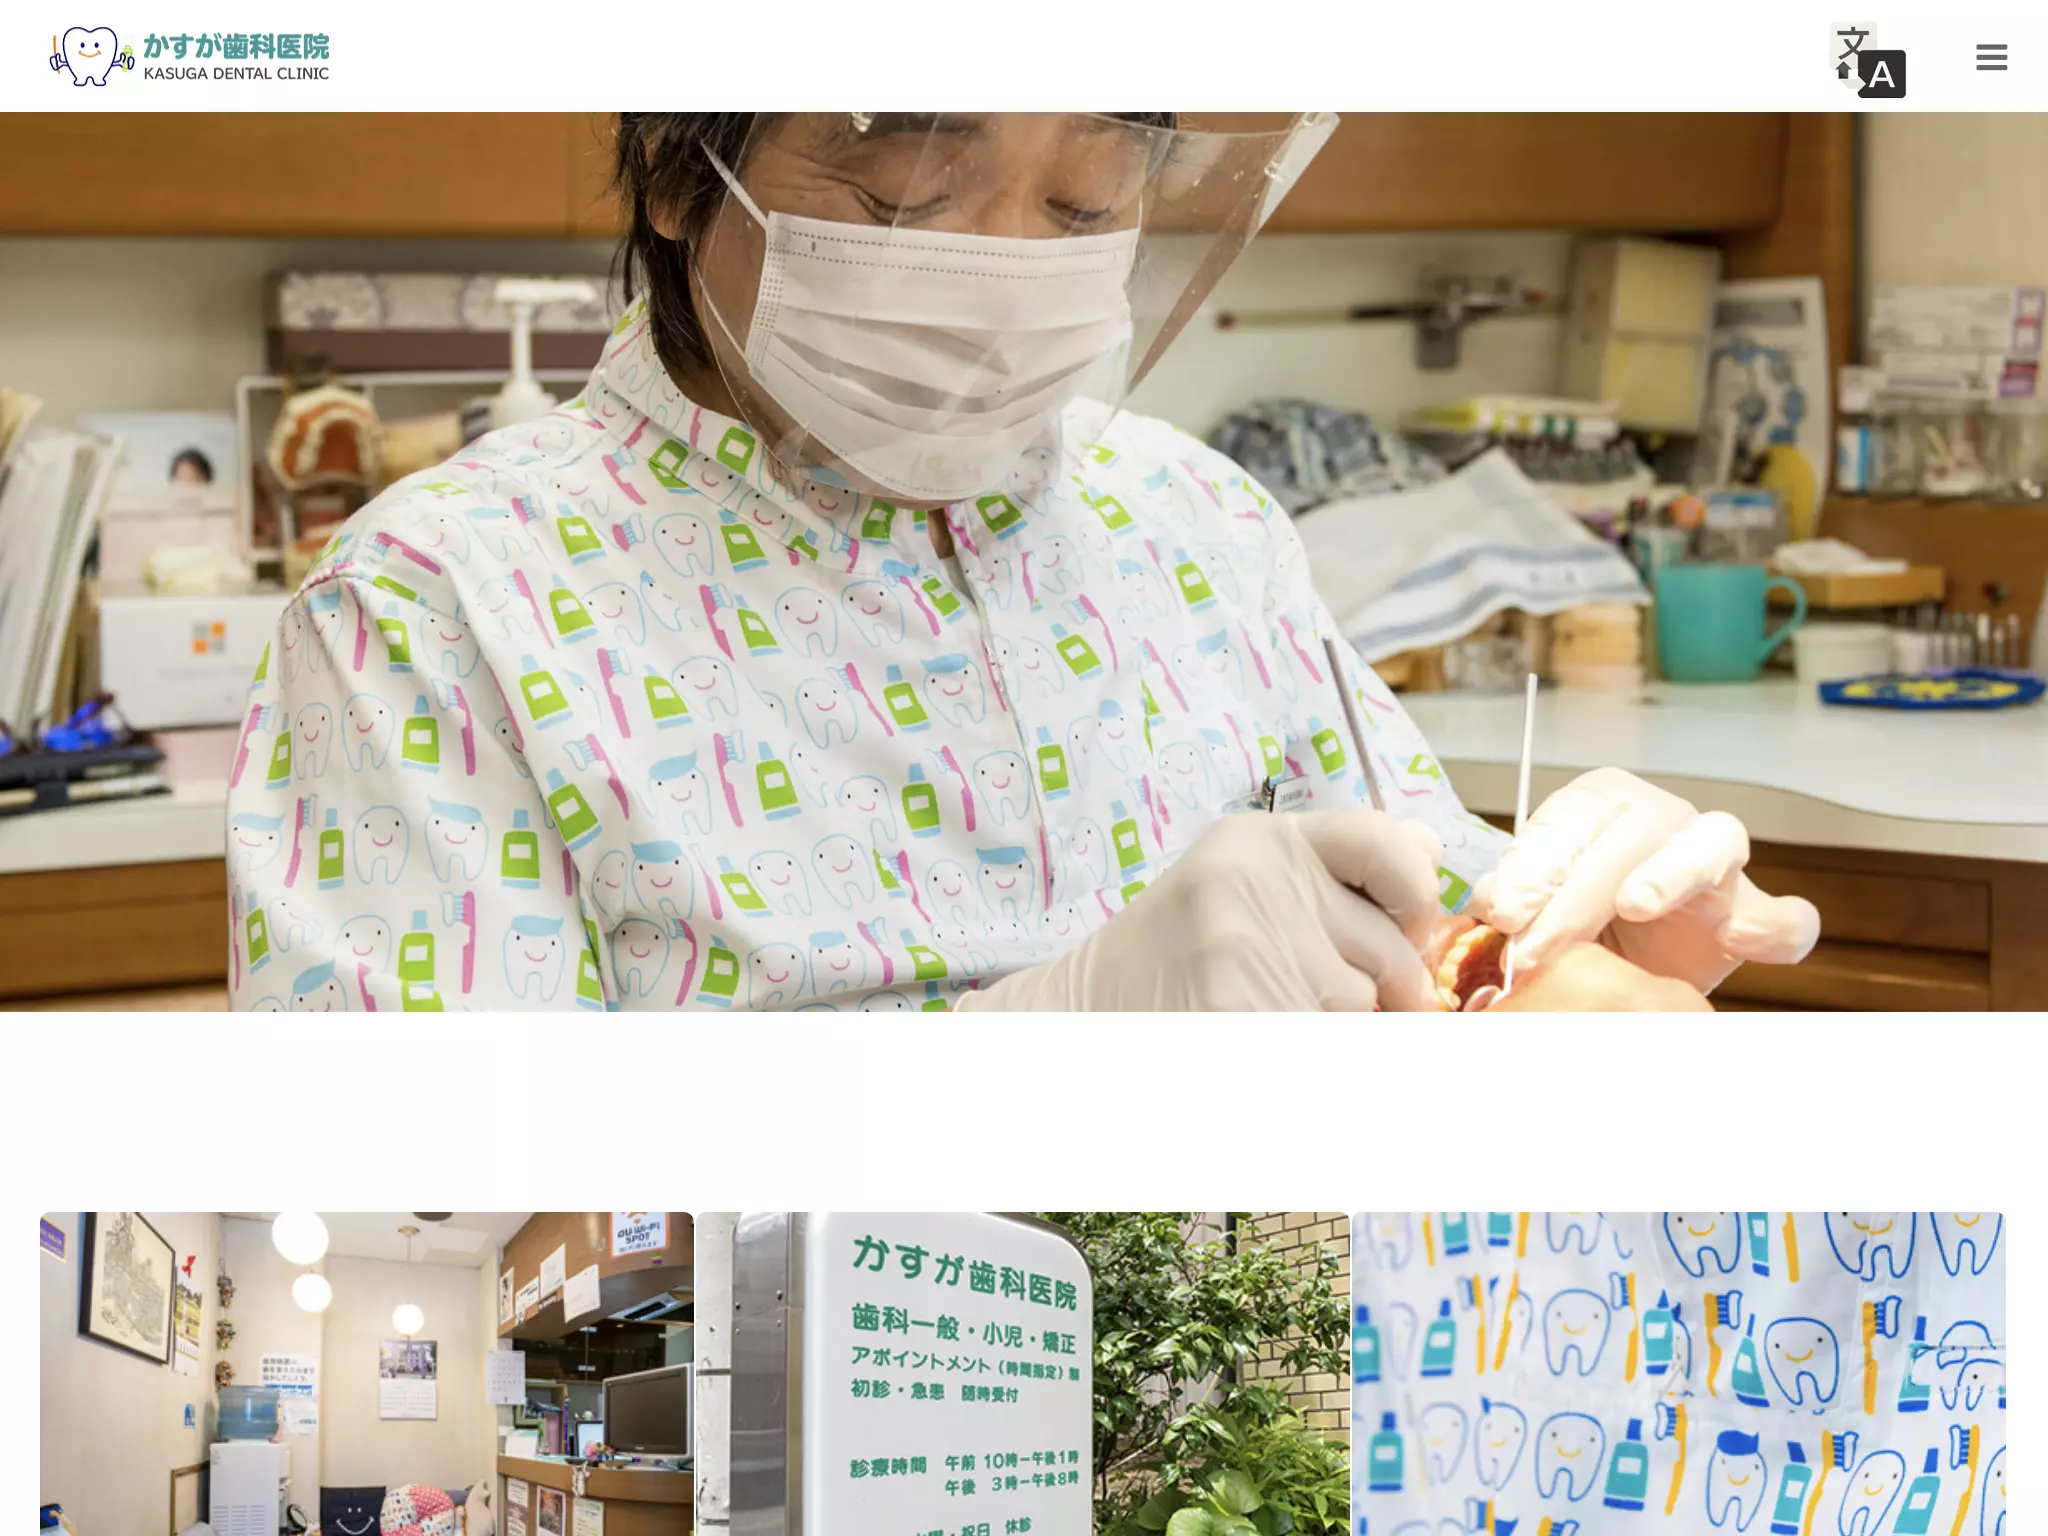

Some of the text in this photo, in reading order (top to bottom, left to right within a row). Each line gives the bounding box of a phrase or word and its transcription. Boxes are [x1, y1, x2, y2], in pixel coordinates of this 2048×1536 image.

[853, 1234, 1076, 1311] かすが歯科医院
[850, 1456, 927, 1479] 診療時間
[945, 1454, 975, 1472] 午前
[944, 1479, 975, 1496] 午後
